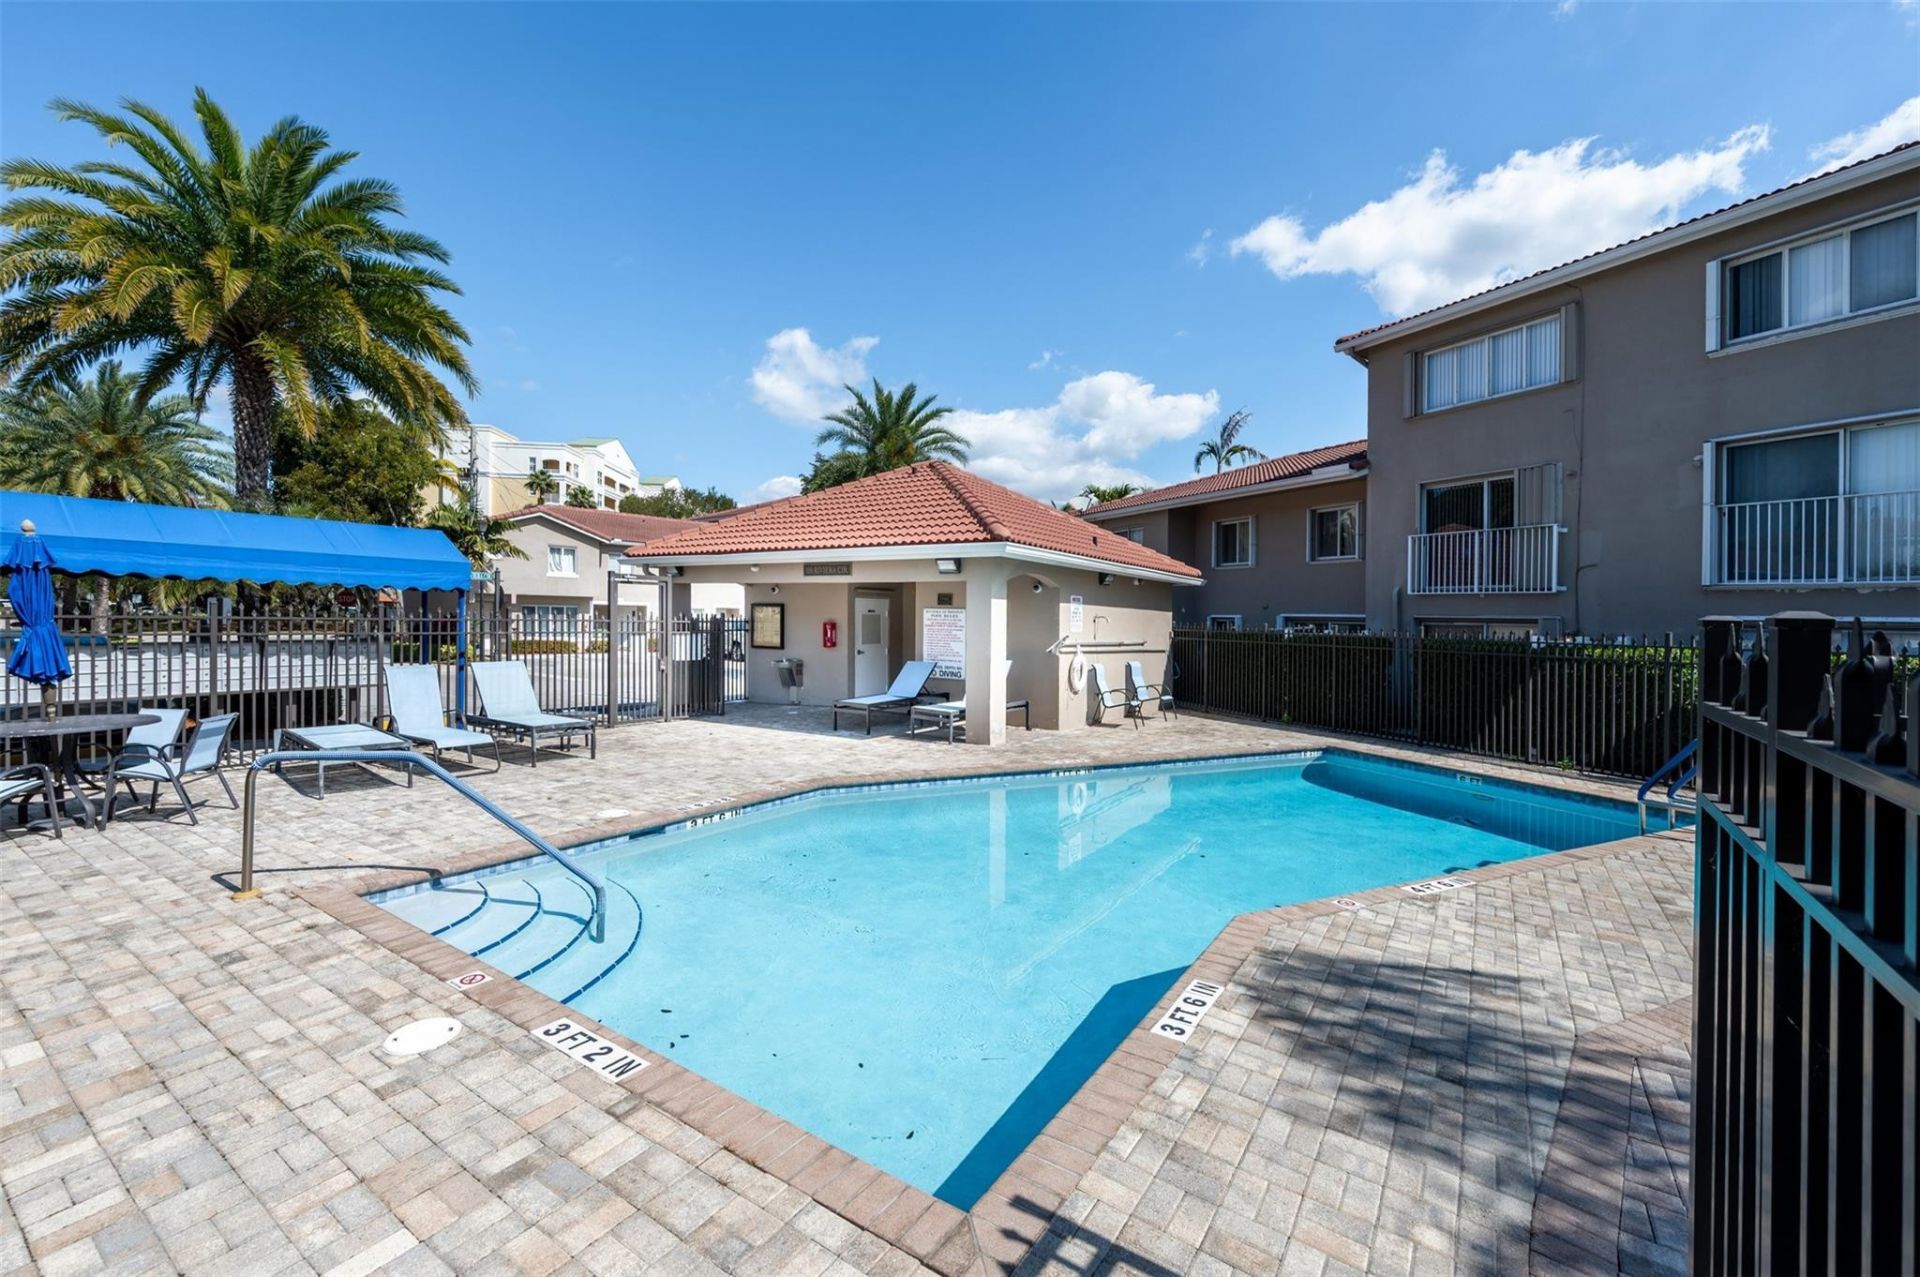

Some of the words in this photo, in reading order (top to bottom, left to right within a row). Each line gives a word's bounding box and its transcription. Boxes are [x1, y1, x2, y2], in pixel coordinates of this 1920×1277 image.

[338, 595, 357, 603] STOP
[939, 670, 962, 678] DIVING
[1190, 981, 1220, 997] IN
[1182, 996, 1207, 1008] 6
[1168, 1006, 1200, 1025] FT
[1160, 1023, 1186, 1036] 3
[543, 1023, 571, 1037] 3
[557, 1031, 598, 1051] FT
[582, 1045, 613, 1063] 2
[602, 1055, 642, 1078] IN
